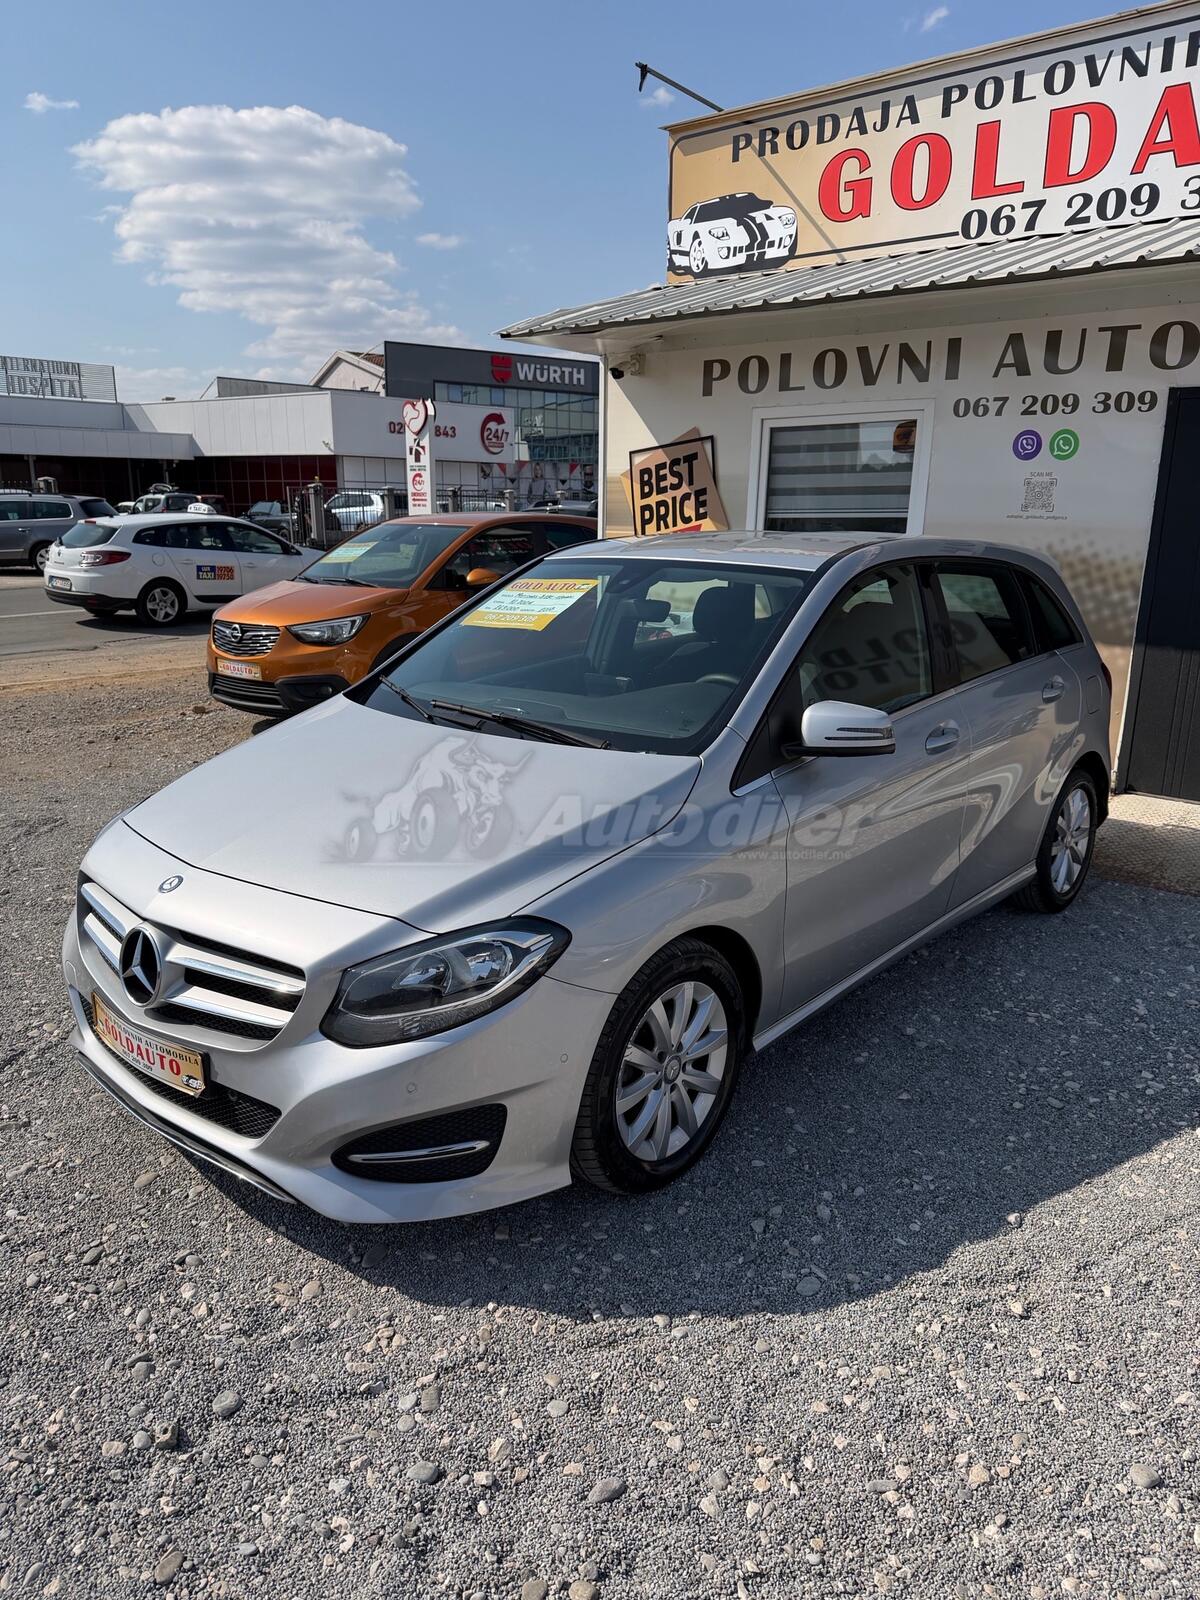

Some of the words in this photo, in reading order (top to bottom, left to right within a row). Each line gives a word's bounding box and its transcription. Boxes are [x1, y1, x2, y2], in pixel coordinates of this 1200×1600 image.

[731, 94, 920, 162] PRODAJA
[818, 81, 1200, 223] GOLDA
[960, 199, 1047, 240] 067
[1064, 182, 1160, 227] 209
[516, 362, 585, 386] WÜRTH
[702, 337, 963, 397] POLOVNI
[992, 319, 1200, 378] AUTO
[952, 396, 1010, 418] 067
[1019, 393, 1080, 416] 209
[1091, 390, 1159, 413] 309
[434, 425, 457, 438] 843
[486, 427, 509, 442] 24/7
[639, 452, 698, 500] BEST
[640, 487, 708, 535] PRICE
[511, 582, 543, 590] GOLD
[546, 583, 577, 591] AUTO
[104, 1018, 181, 1076] GOLDAUTO
[145, 1039, 199, 1066] AUTOMOBILA
